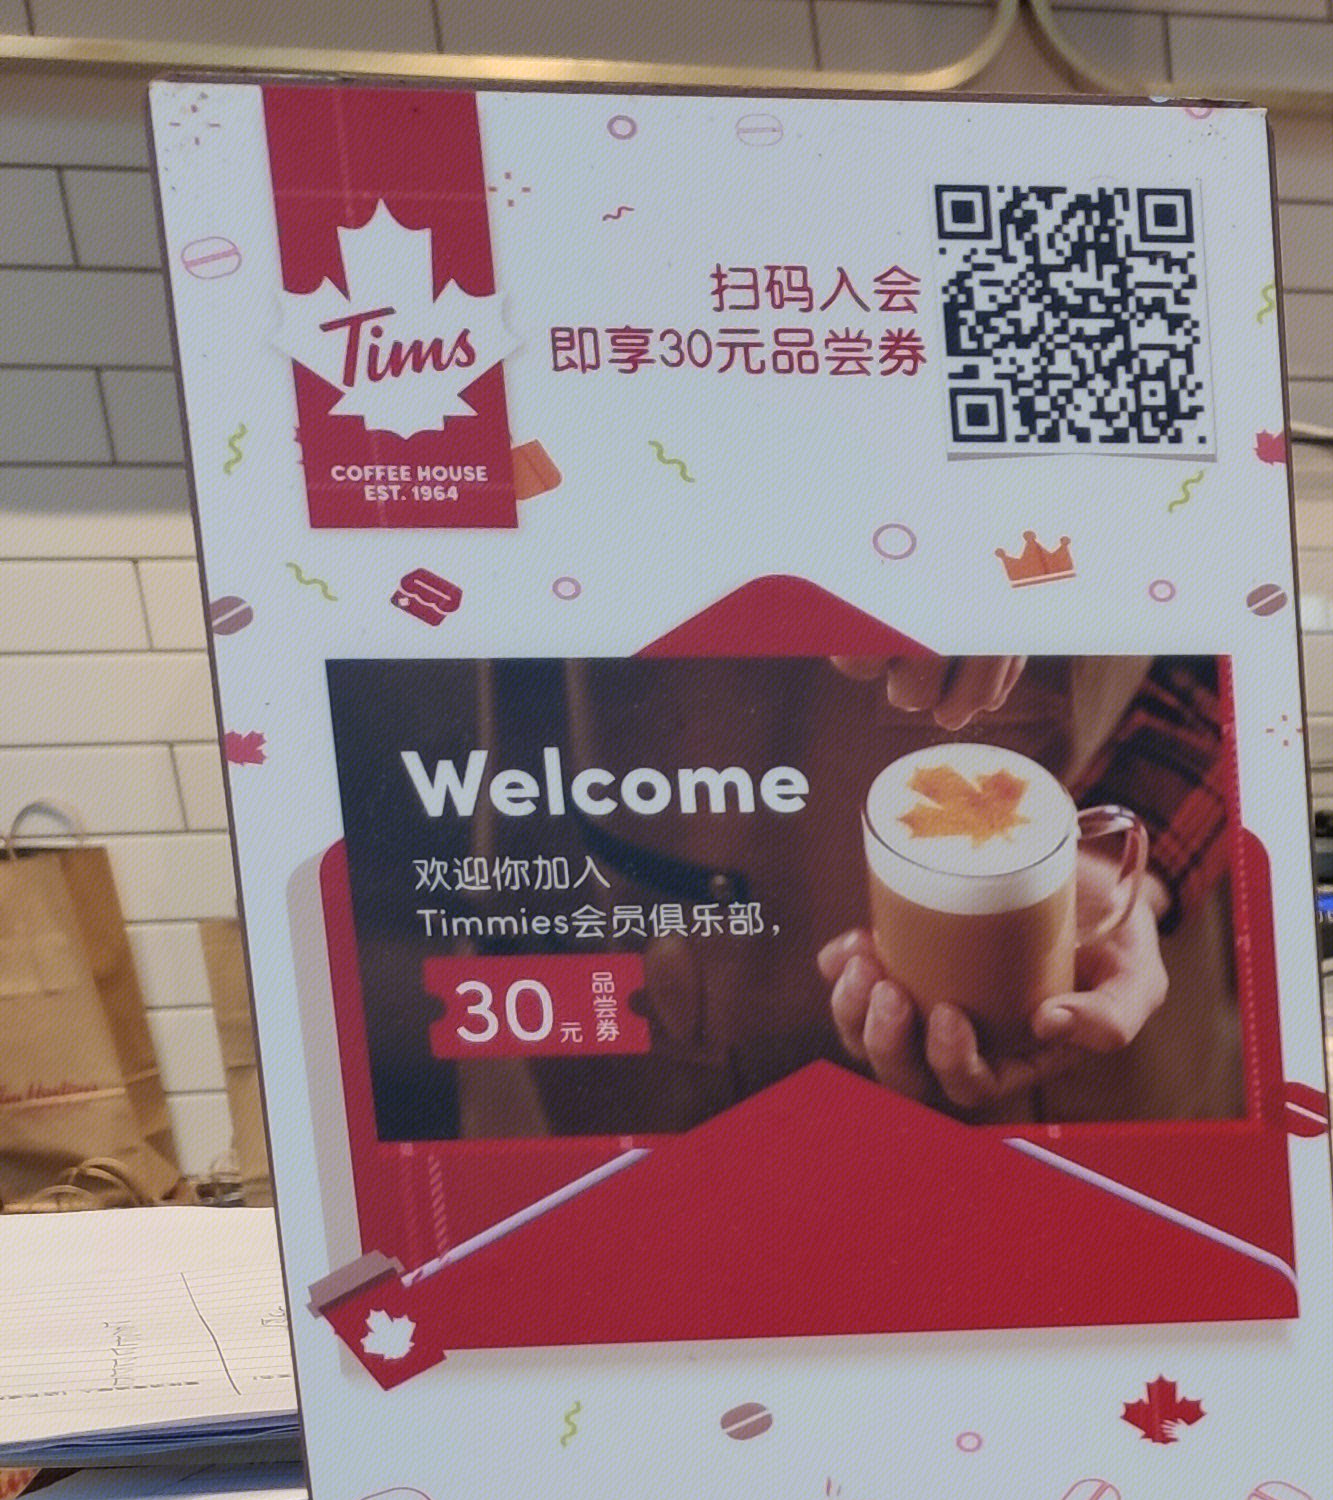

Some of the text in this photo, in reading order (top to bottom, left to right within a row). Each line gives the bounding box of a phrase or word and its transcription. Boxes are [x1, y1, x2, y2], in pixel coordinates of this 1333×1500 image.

[711, 263, 921, 314] 扫码入会
[319, 306, 477, 388] Tims
[550, 325, 927, 377] 即享30元品尝券
[331, 464, 488, 483] COFFEE HOUSE
[364, 485, 459, 502] EST. 1964
[401, 746, 809, 817] Welcome
[411, 855, 611, 892] 欢迎你加入
[591, 971, 621, 1042] 品尝券
